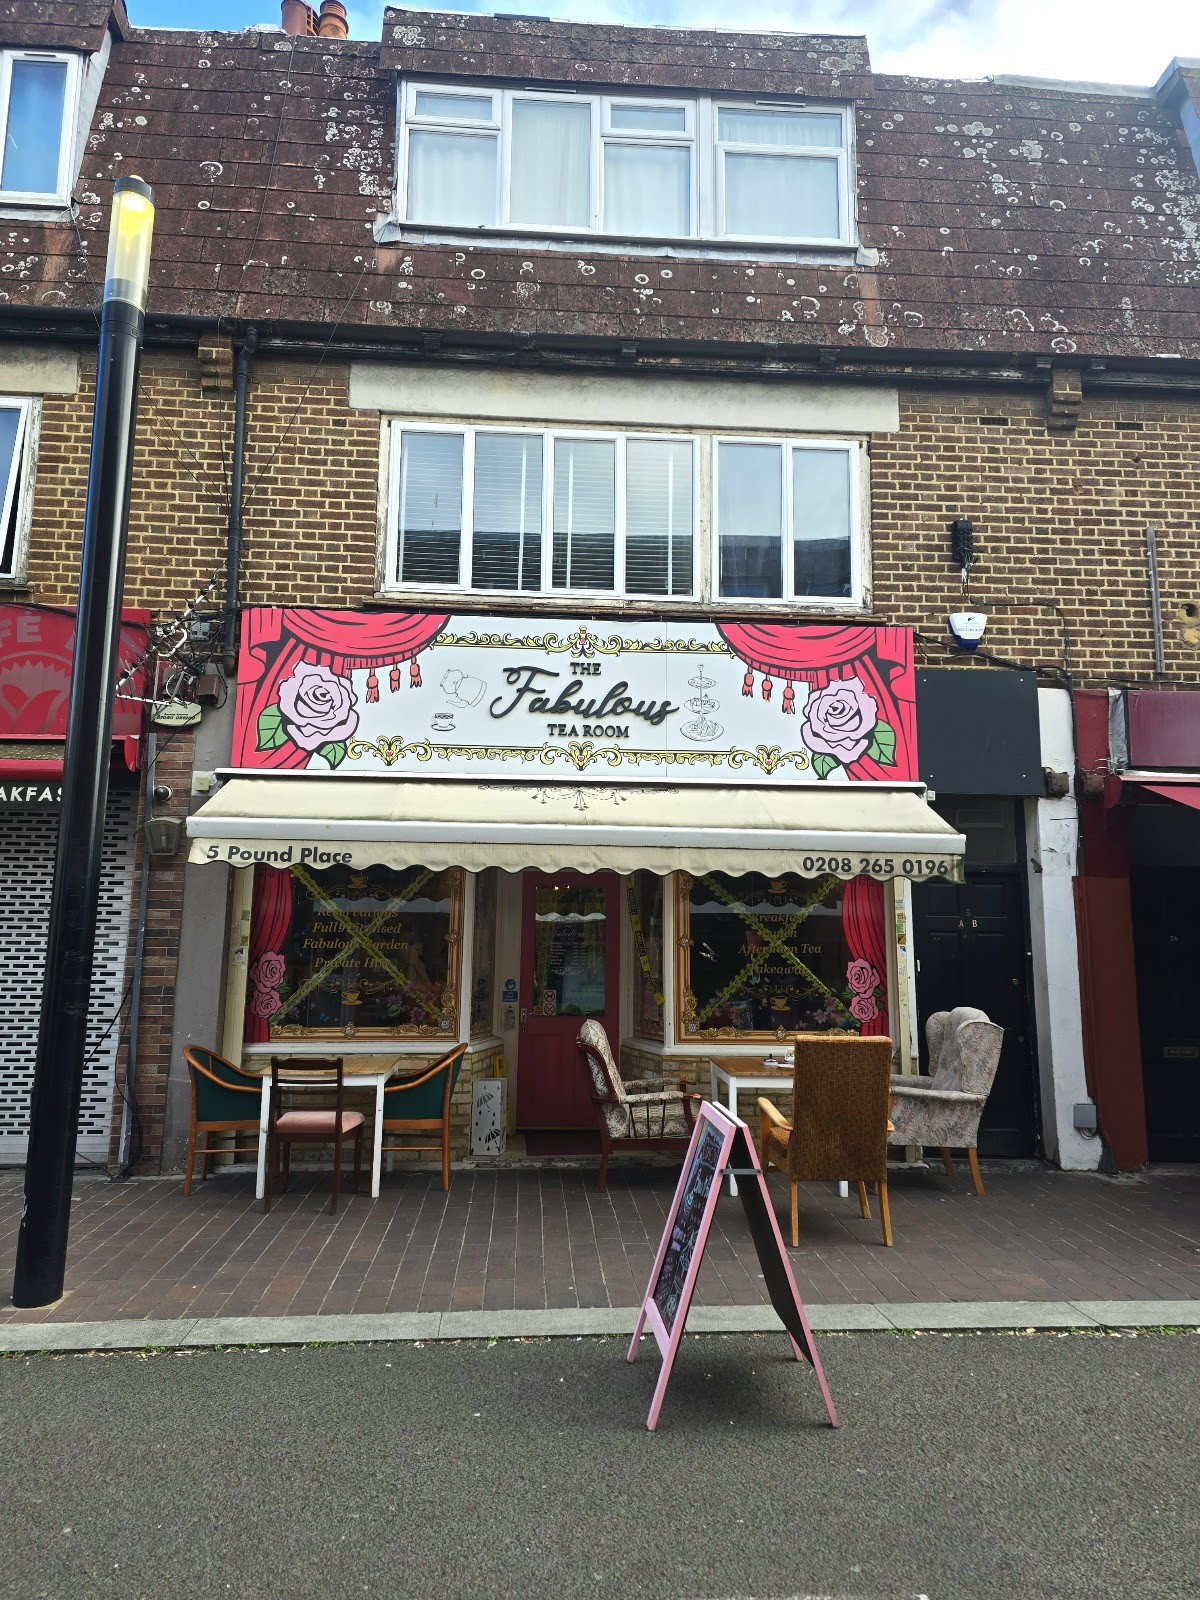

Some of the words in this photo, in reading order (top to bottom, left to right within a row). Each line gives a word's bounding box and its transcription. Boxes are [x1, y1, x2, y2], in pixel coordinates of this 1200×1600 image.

[570, 662, 602, 675] THE
[489, 665, 680, 725] Fabulous
[547, 723, 580, 737] TEA
[583, 724, 630, 738] ROOM
[206, 845, 220, 859] 5
[227, 845, 293, 863] Pound
[300, 846, 353, 863] Place
[802, 856, 852, 872] 0208
[859, 857, 895, 874] 265
[902, 859, 949, 875] 0196
[958, 919, 965, 928] A
[971, 919, 978, 928] B
[800, 943, 822, 954] Tea
